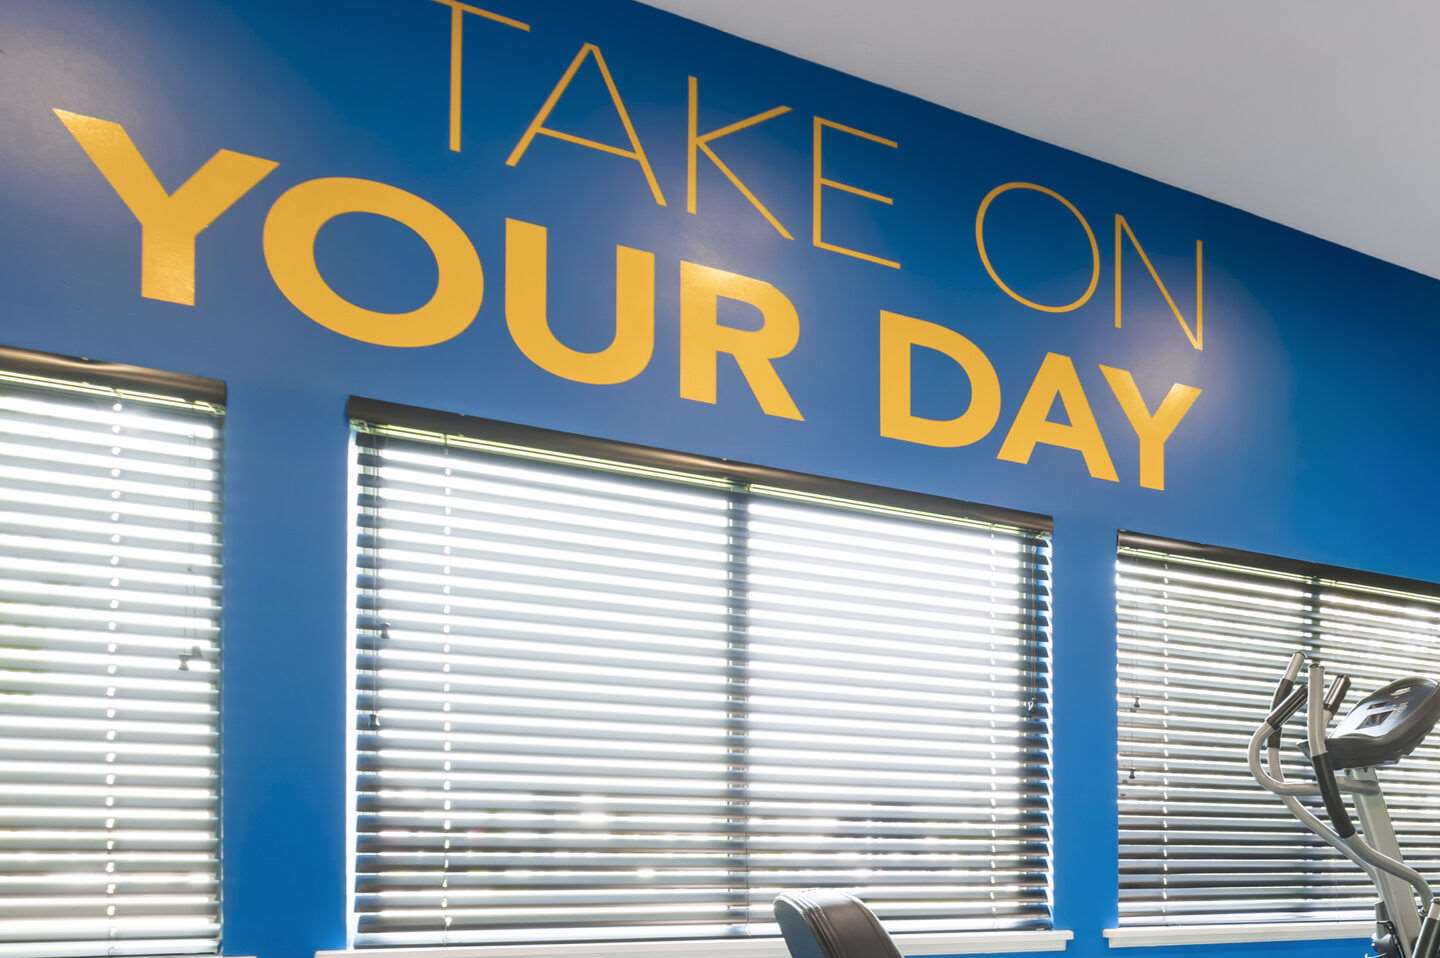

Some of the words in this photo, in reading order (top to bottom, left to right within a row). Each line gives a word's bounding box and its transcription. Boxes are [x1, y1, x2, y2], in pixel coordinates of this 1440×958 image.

[52, 108, 804, 421] YOUR
[879, 309, 1201, 491] DAY
[437, 0, 901, 270] TAKE
[975, 182, 1204, 350] ON
